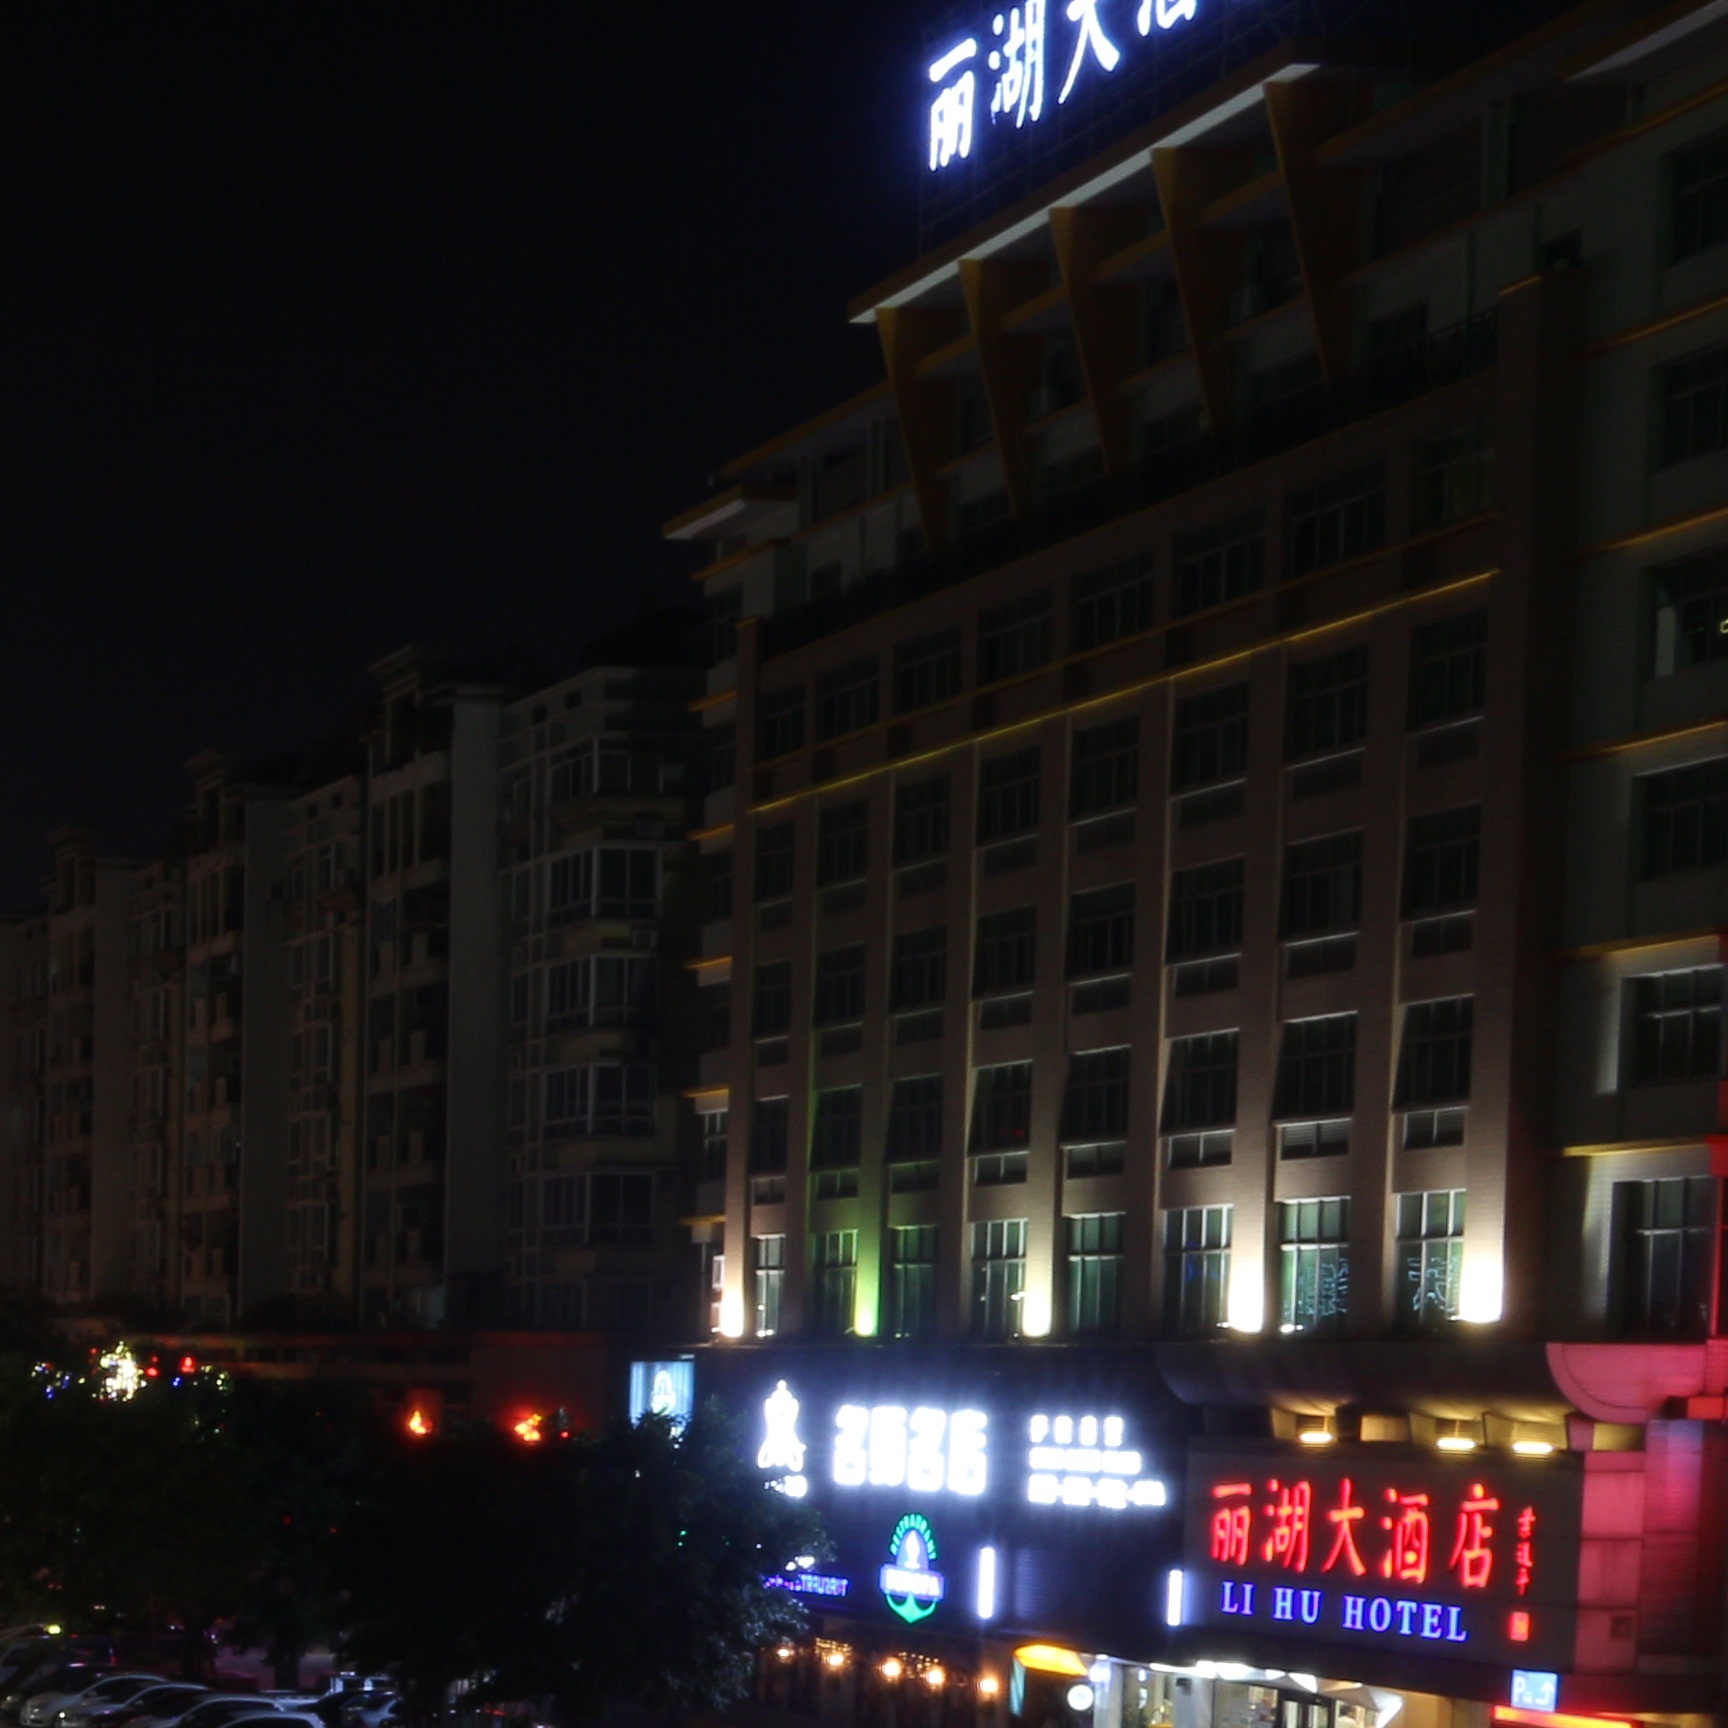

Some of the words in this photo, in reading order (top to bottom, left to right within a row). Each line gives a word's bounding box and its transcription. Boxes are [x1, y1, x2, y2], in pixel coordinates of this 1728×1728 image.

[1209, 1478, 1501, 1589] 丽湖大酒店
[1220, 1580, 1256, 1616] LI
[1272, 1586, 1324, 1625] HU
[1342, 1594, 1468, 1643] HOTEL
